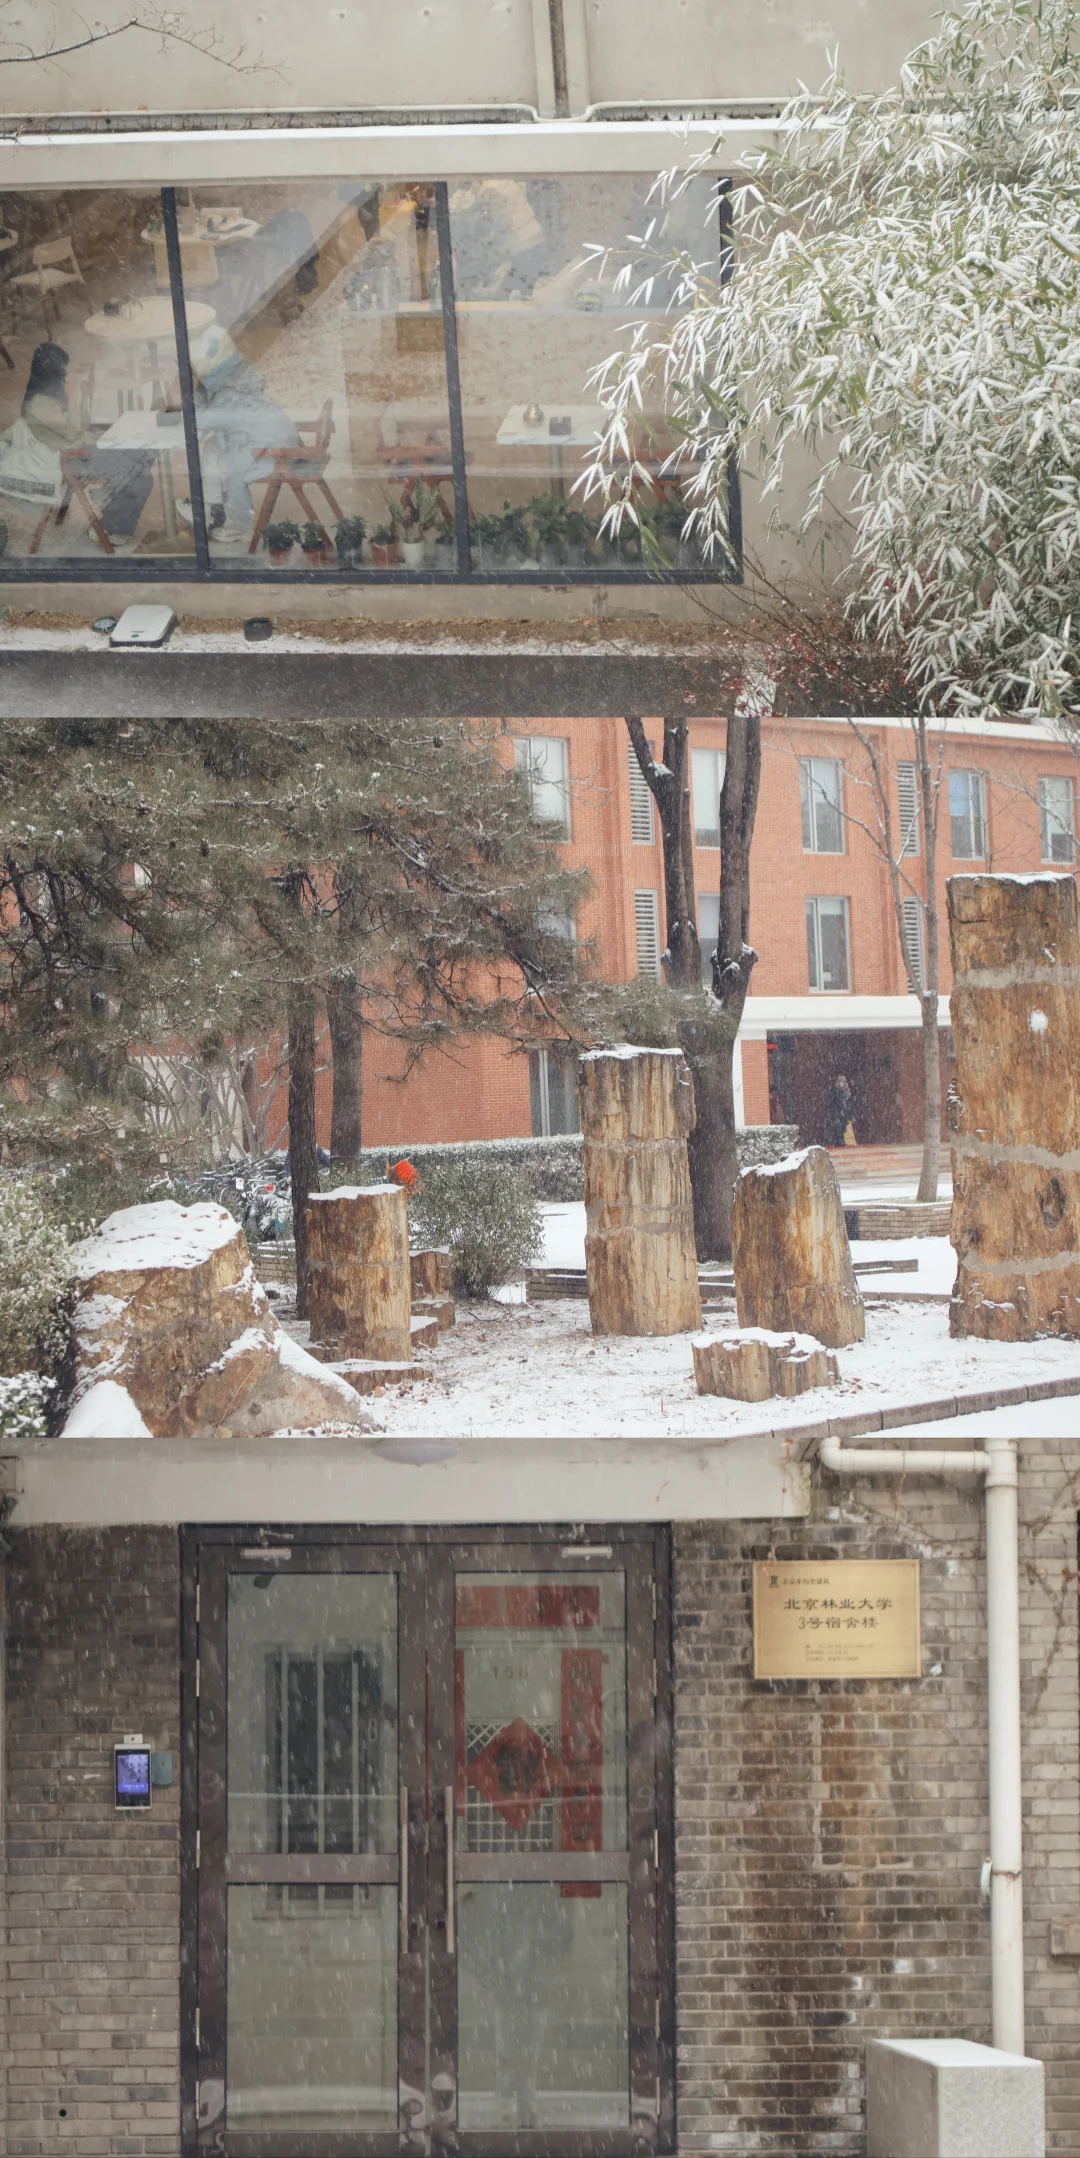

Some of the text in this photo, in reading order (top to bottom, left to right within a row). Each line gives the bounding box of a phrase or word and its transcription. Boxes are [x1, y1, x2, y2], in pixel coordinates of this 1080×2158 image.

[783, 1597, 893, 1611] 北京林业大学
[798, 1616, 878, 1629] 3号宿舍楼
